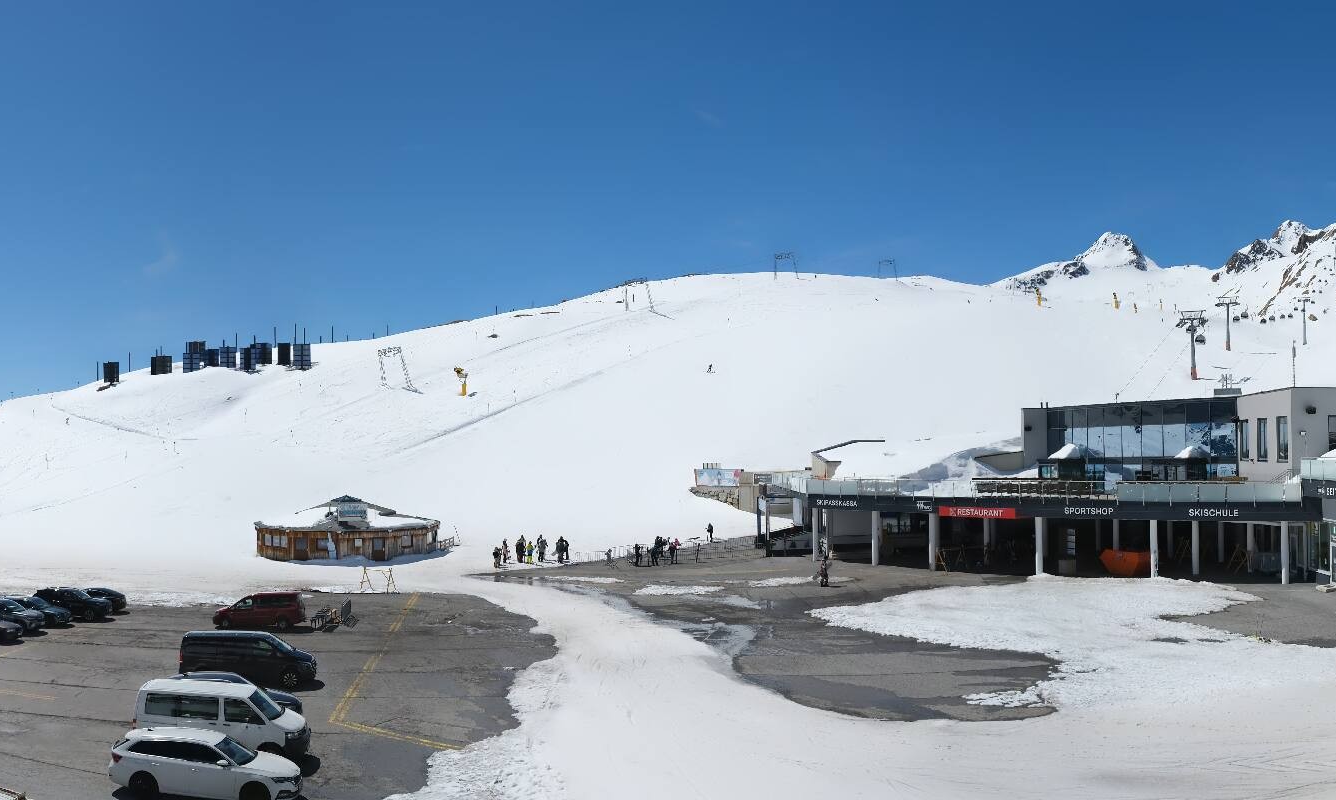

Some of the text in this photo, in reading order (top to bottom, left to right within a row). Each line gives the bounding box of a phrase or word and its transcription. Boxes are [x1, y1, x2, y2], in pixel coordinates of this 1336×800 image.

[957, 508, 1004, 517] RESTAURANT
[1064, 507, 1114, 515] SPORTSHOP
[1188, 508, 1239, 517] SKISCHULE
